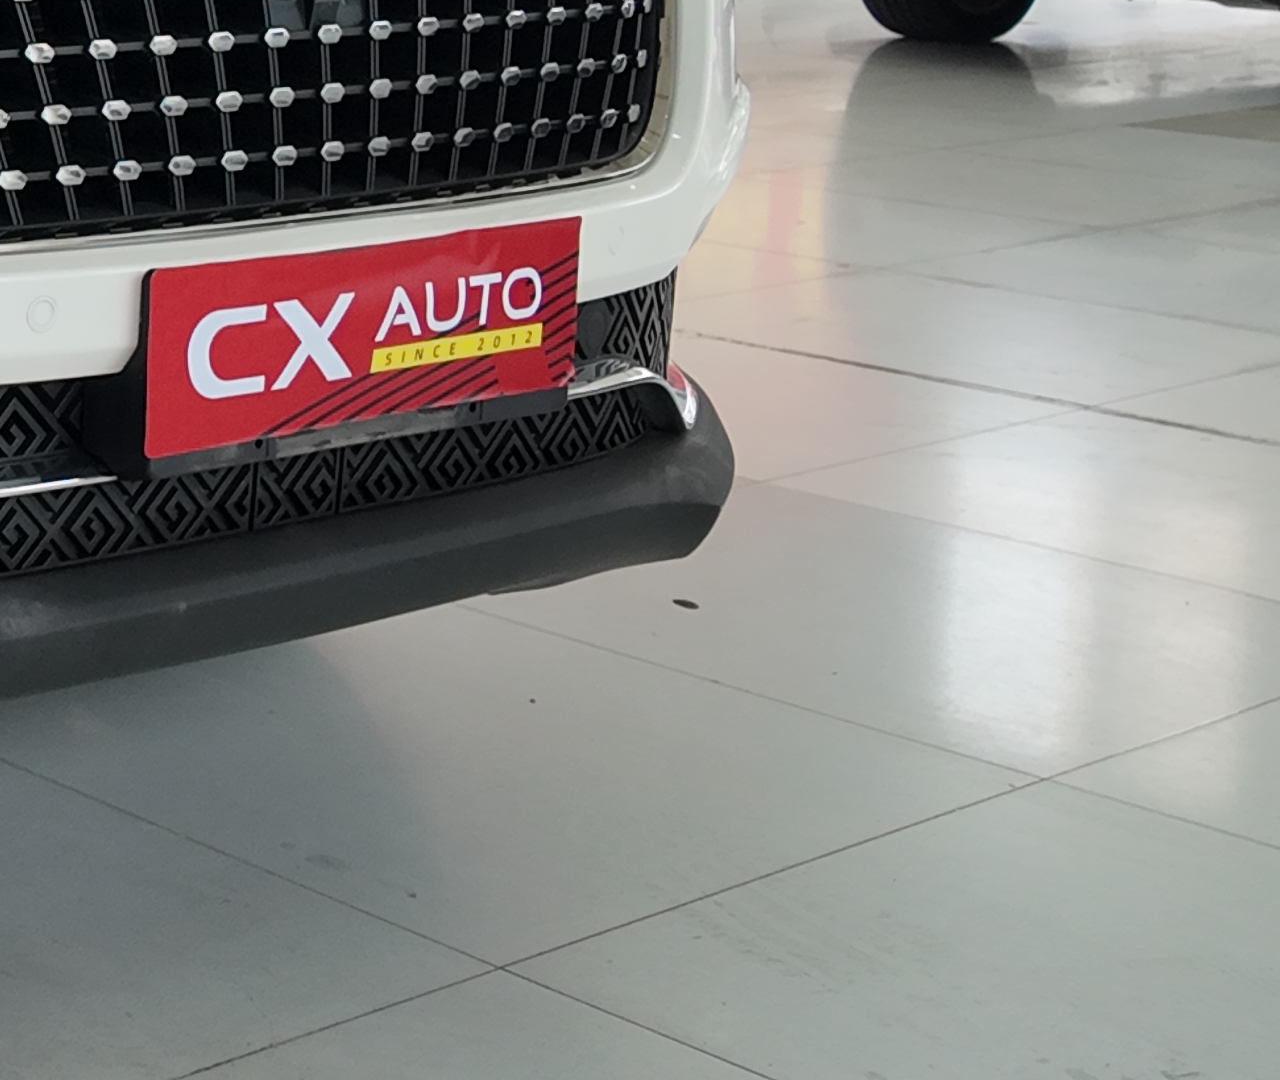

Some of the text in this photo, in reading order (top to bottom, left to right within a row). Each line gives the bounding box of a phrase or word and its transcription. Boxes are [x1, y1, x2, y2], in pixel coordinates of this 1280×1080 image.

[374, 266, 543, 342] AUTO
[187, 291, 356, 400] CX
[384, 330, 534, 367] SINCE 2012
